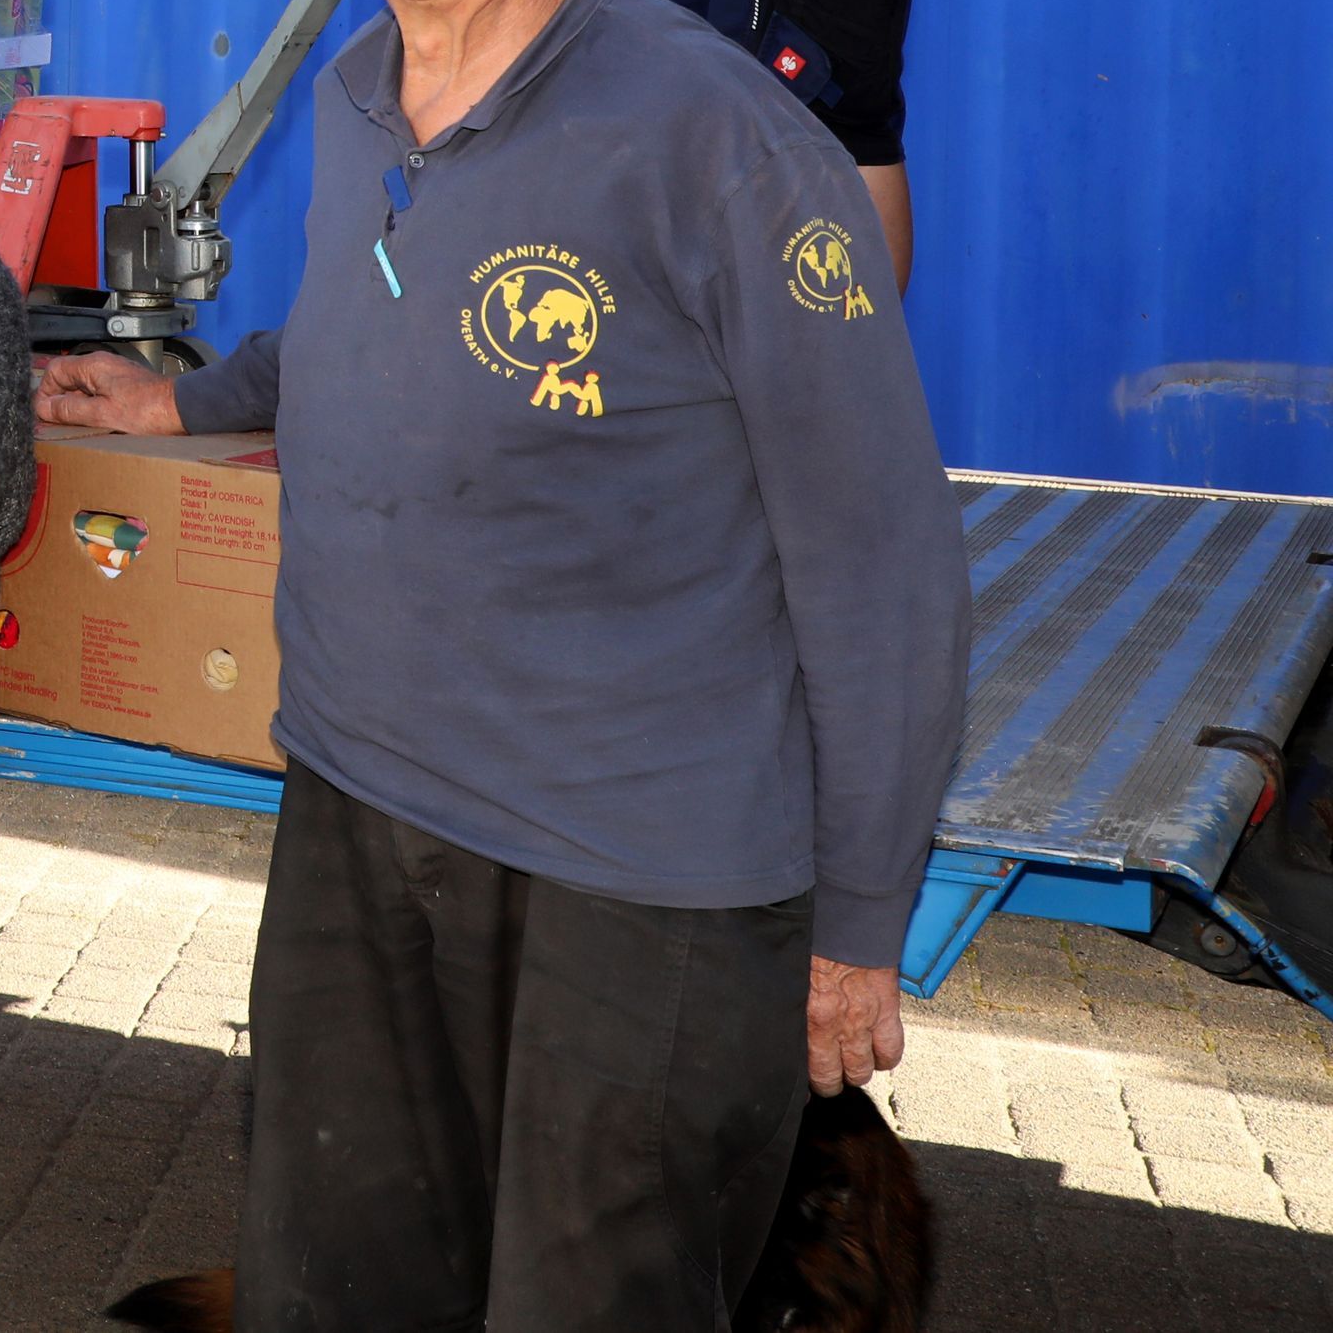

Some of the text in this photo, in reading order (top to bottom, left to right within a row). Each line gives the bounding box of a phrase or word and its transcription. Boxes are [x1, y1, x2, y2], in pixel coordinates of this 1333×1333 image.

[828, 221, 853, 246] HILFE
[469, 244, 616, 314] HUMANITÄRE HILFE
[787, 279, 817, 312] OVERATH
[461, 308, 490, 365] OVERATH
[181, 475, 212, 488] Bananas
[181, 486, 264, 506] Product of COSTA RICA
[181, 509, 255, 527] Variety: CAVENDISH
[181, 520, 213, 532] Minimum
[214, 525, 228, 534] Net
[229, 528, 254, 539] weight:
[181, 531, 265, 552] Minimum Length: 20 cm
[23, 683, 58, 702] Handling
